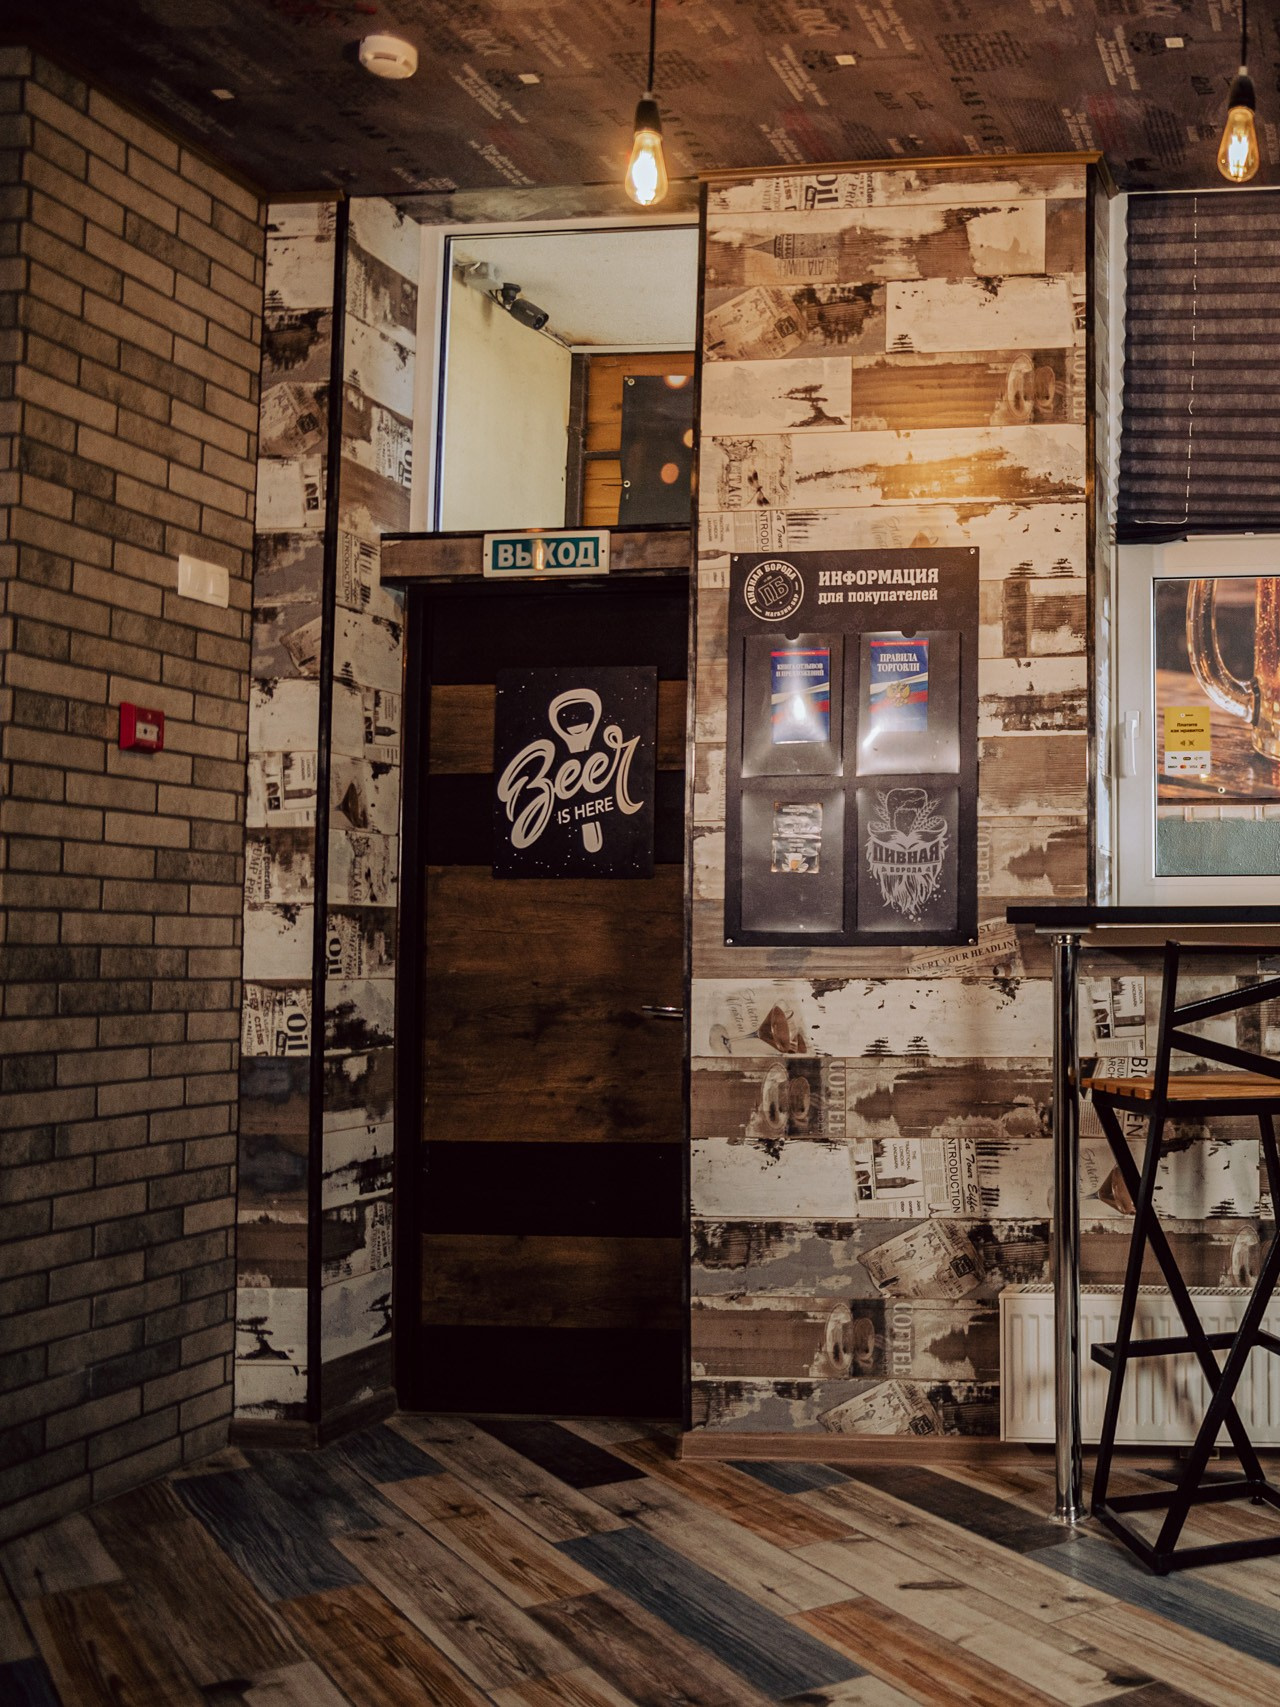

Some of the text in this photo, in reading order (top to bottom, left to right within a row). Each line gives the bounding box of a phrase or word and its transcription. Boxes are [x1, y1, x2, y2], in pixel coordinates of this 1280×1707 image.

[498, 541, 596, 568] ВЫХОД
[764, 563, 797, 581] БОРОДА
[818, 568, 939, 586] ИНФОРМАЦИЯ
[818, 588, 938, 605] для покупателей
[880, 652, 918, 662] ПРАВИЛА
[877, 663, 920, 672] ТОРГОВЛИ
[497, 724, 644, 849] Beer
[557, 796, 614, 825] IS HERE
[873, 841, 940, 863] ПИВНАЯ
[287, 1013, 308, 1050] Oil
